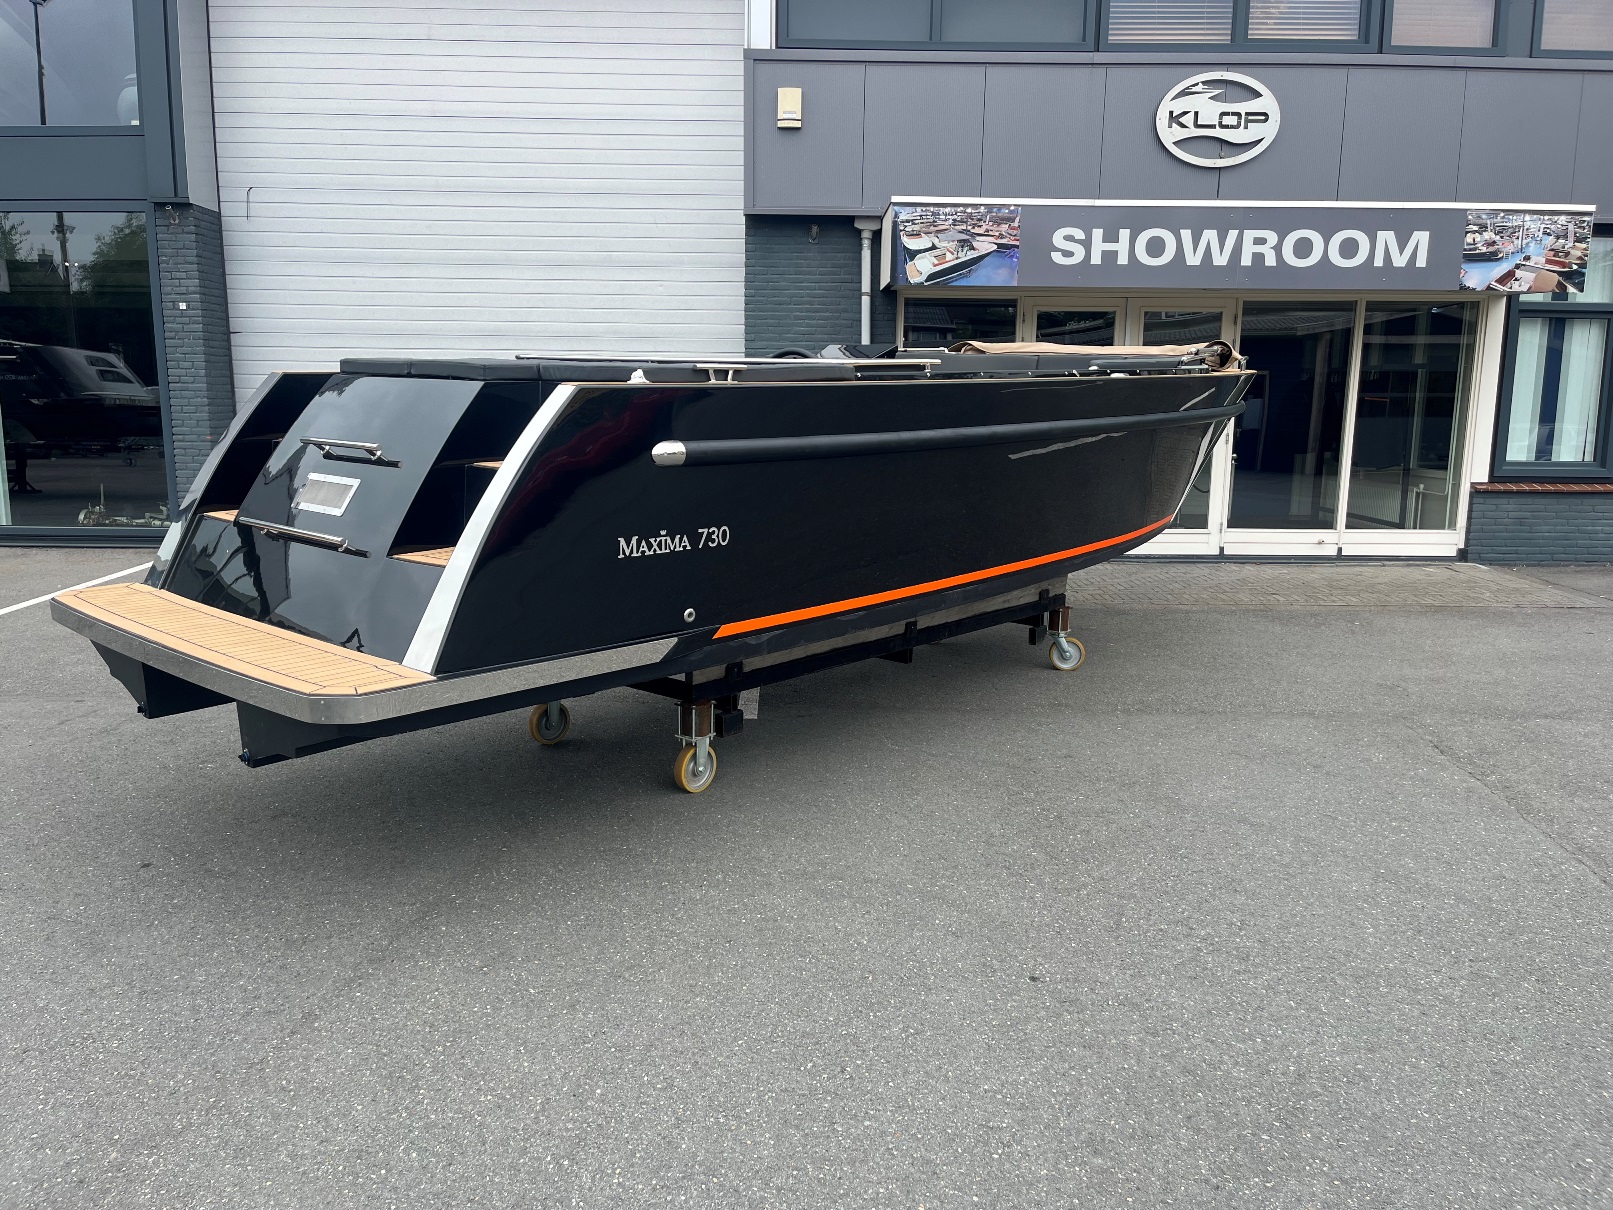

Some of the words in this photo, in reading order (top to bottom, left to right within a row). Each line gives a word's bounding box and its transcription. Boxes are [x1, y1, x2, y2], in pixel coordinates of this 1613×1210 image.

[1167, 110, 1270, 130] KLOP
[1050, 226, 1431, 268] SHOWROOM
[697, 525, 730, 549] 730
